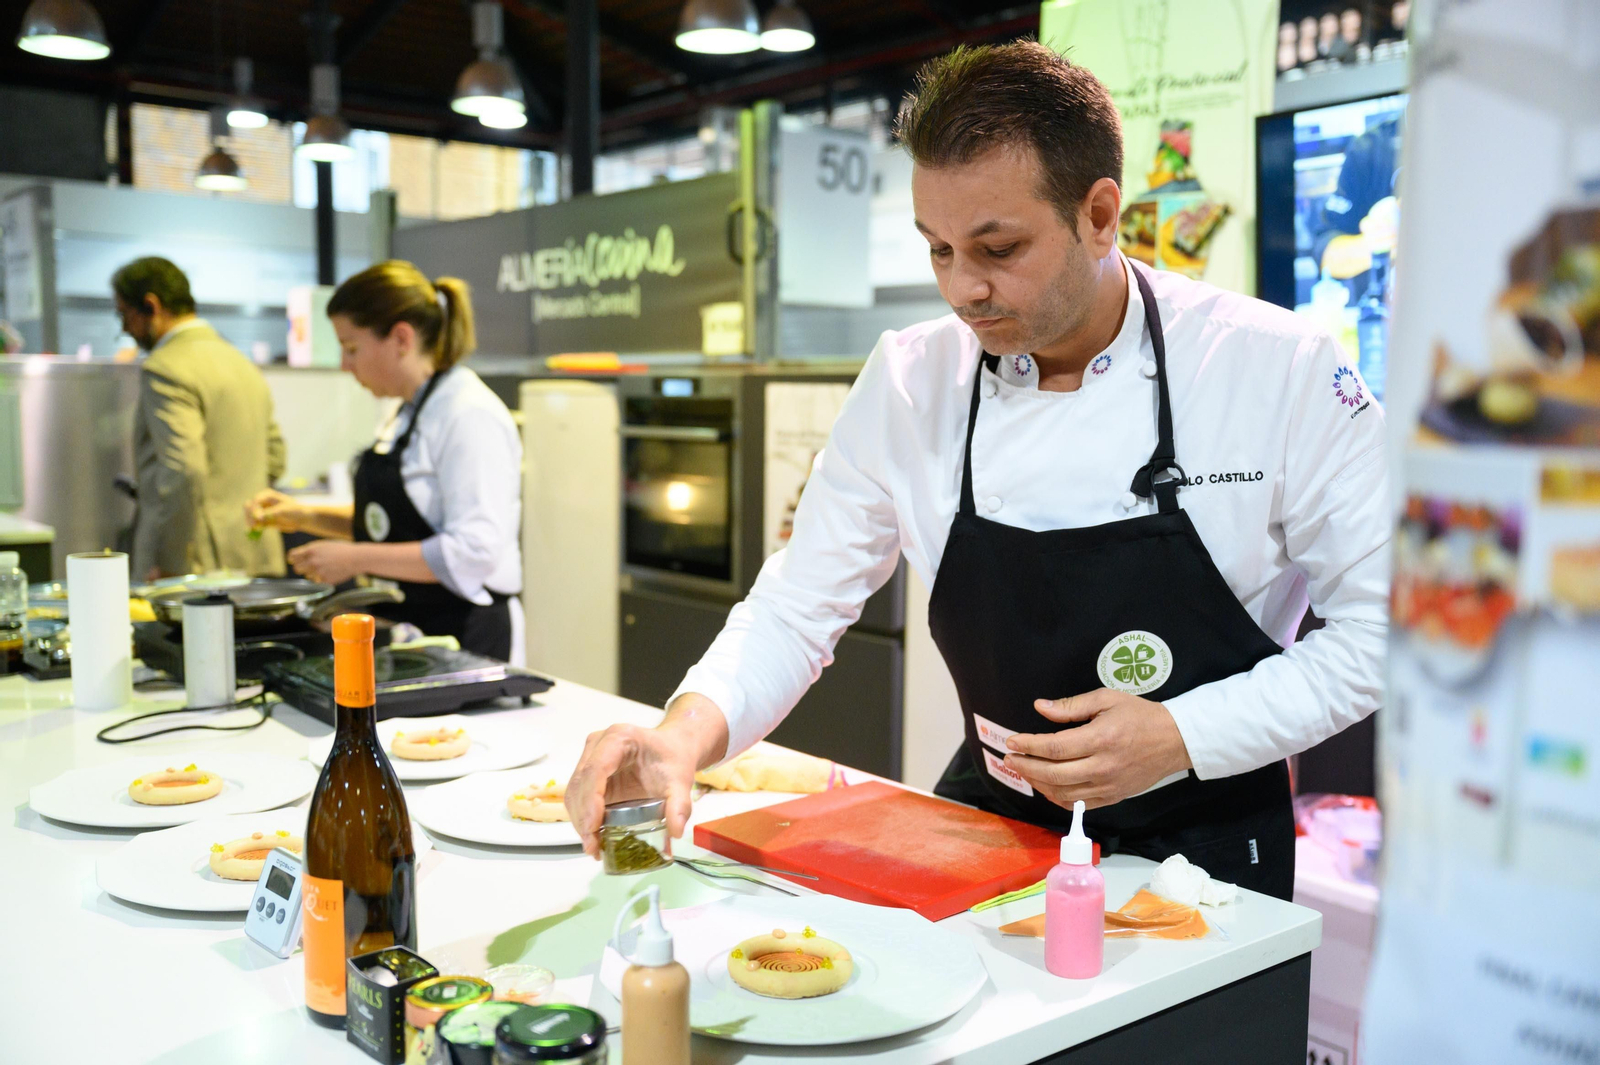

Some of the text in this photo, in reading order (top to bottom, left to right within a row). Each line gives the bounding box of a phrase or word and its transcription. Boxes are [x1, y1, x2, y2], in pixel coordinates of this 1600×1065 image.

[818, 144, 868, 195] 50
[1209, 470, 1264, 484] CASTILLO
[1118, 634, 1147, 645] ASHAL
